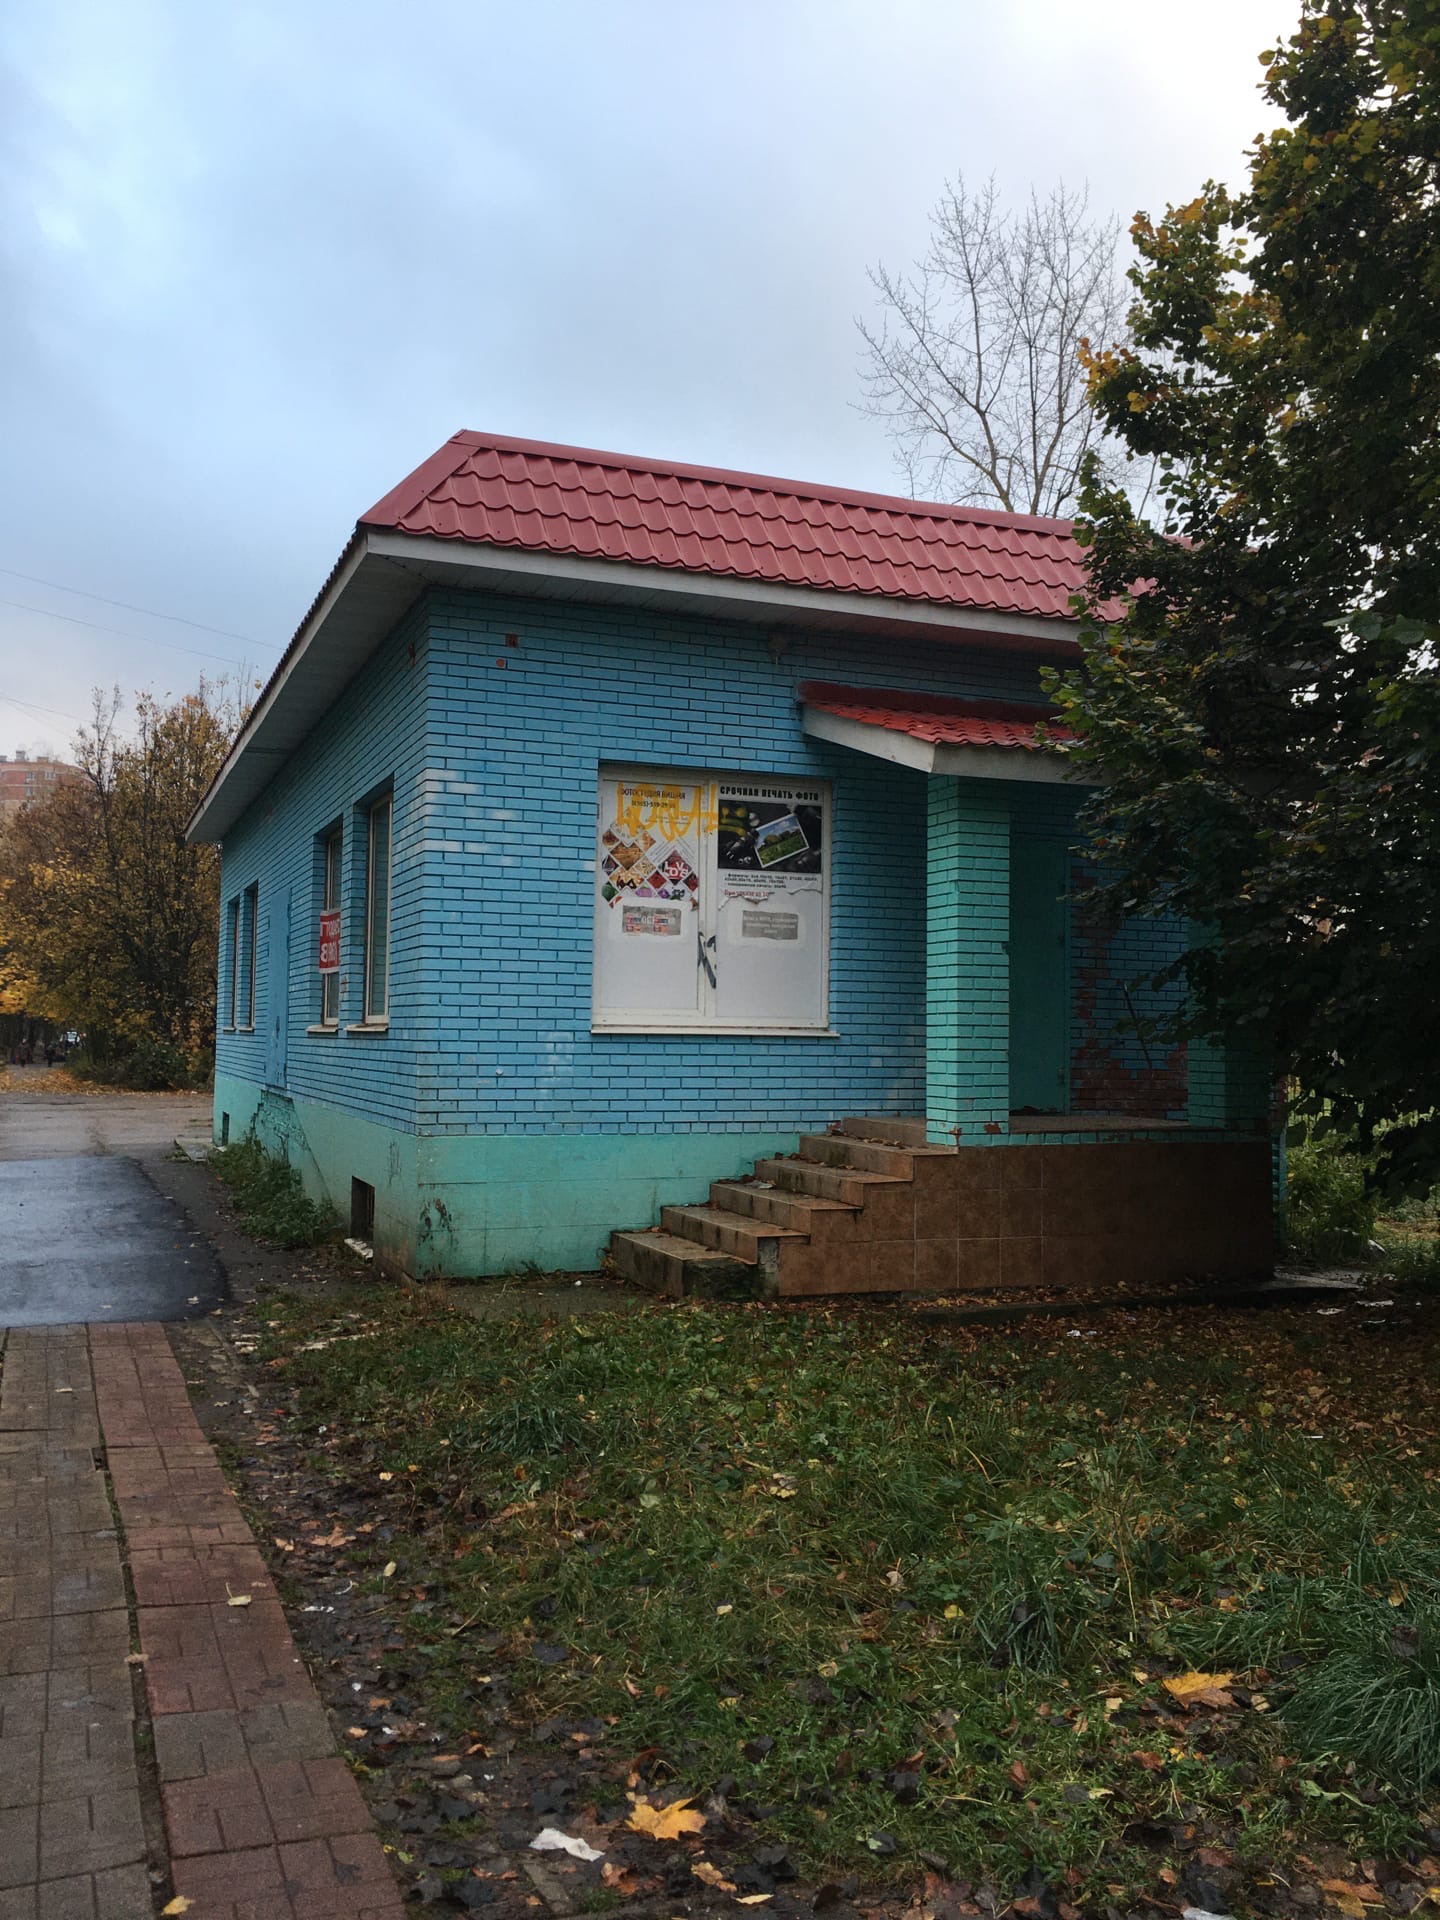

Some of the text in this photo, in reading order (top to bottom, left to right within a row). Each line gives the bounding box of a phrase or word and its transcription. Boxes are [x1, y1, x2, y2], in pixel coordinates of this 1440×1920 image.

[720, 786, 819, 801] СРОЧНАЯ ПЕЧАТЬ ФОТО
